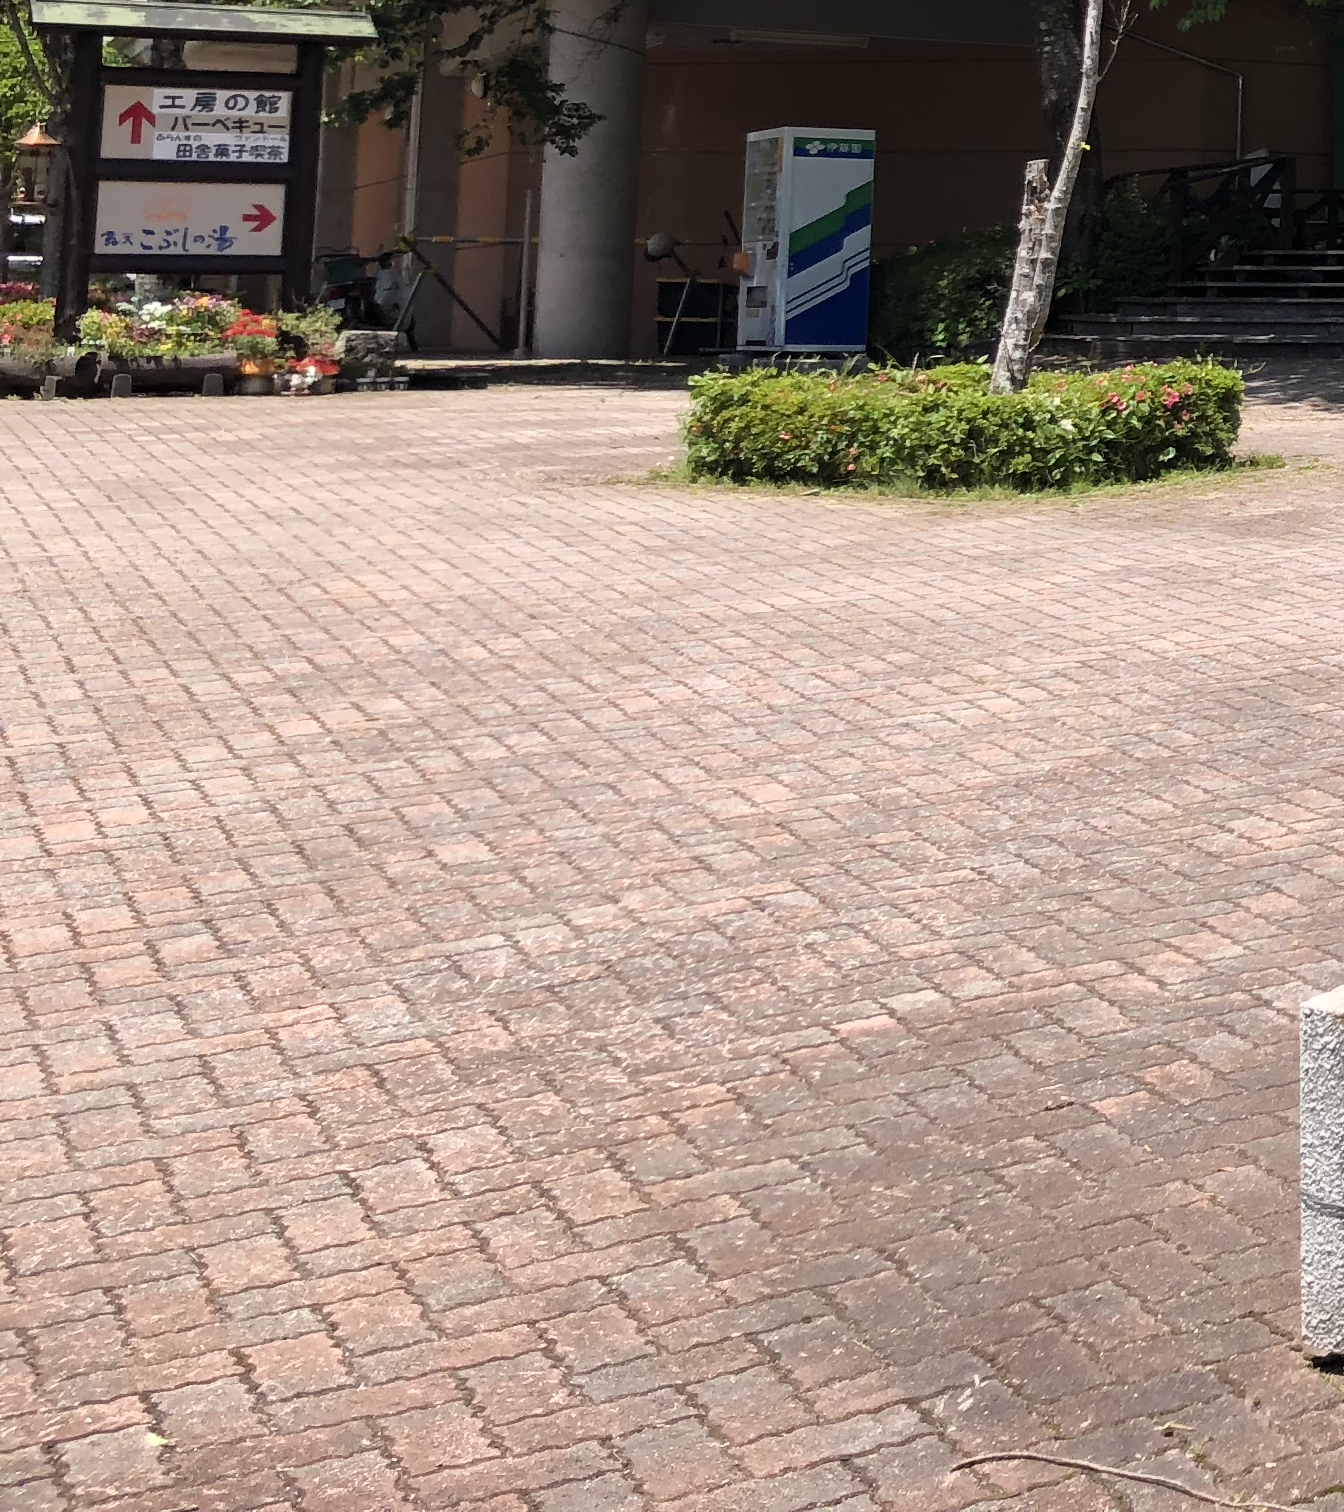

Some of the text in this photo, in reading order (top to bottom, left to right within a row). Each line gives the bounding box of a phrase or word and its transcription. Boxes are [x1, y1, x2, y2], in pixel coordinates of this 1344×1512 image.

[158, 92, 283, 114] 工房の館
[171, 114, 286, 133] バーベキュー
